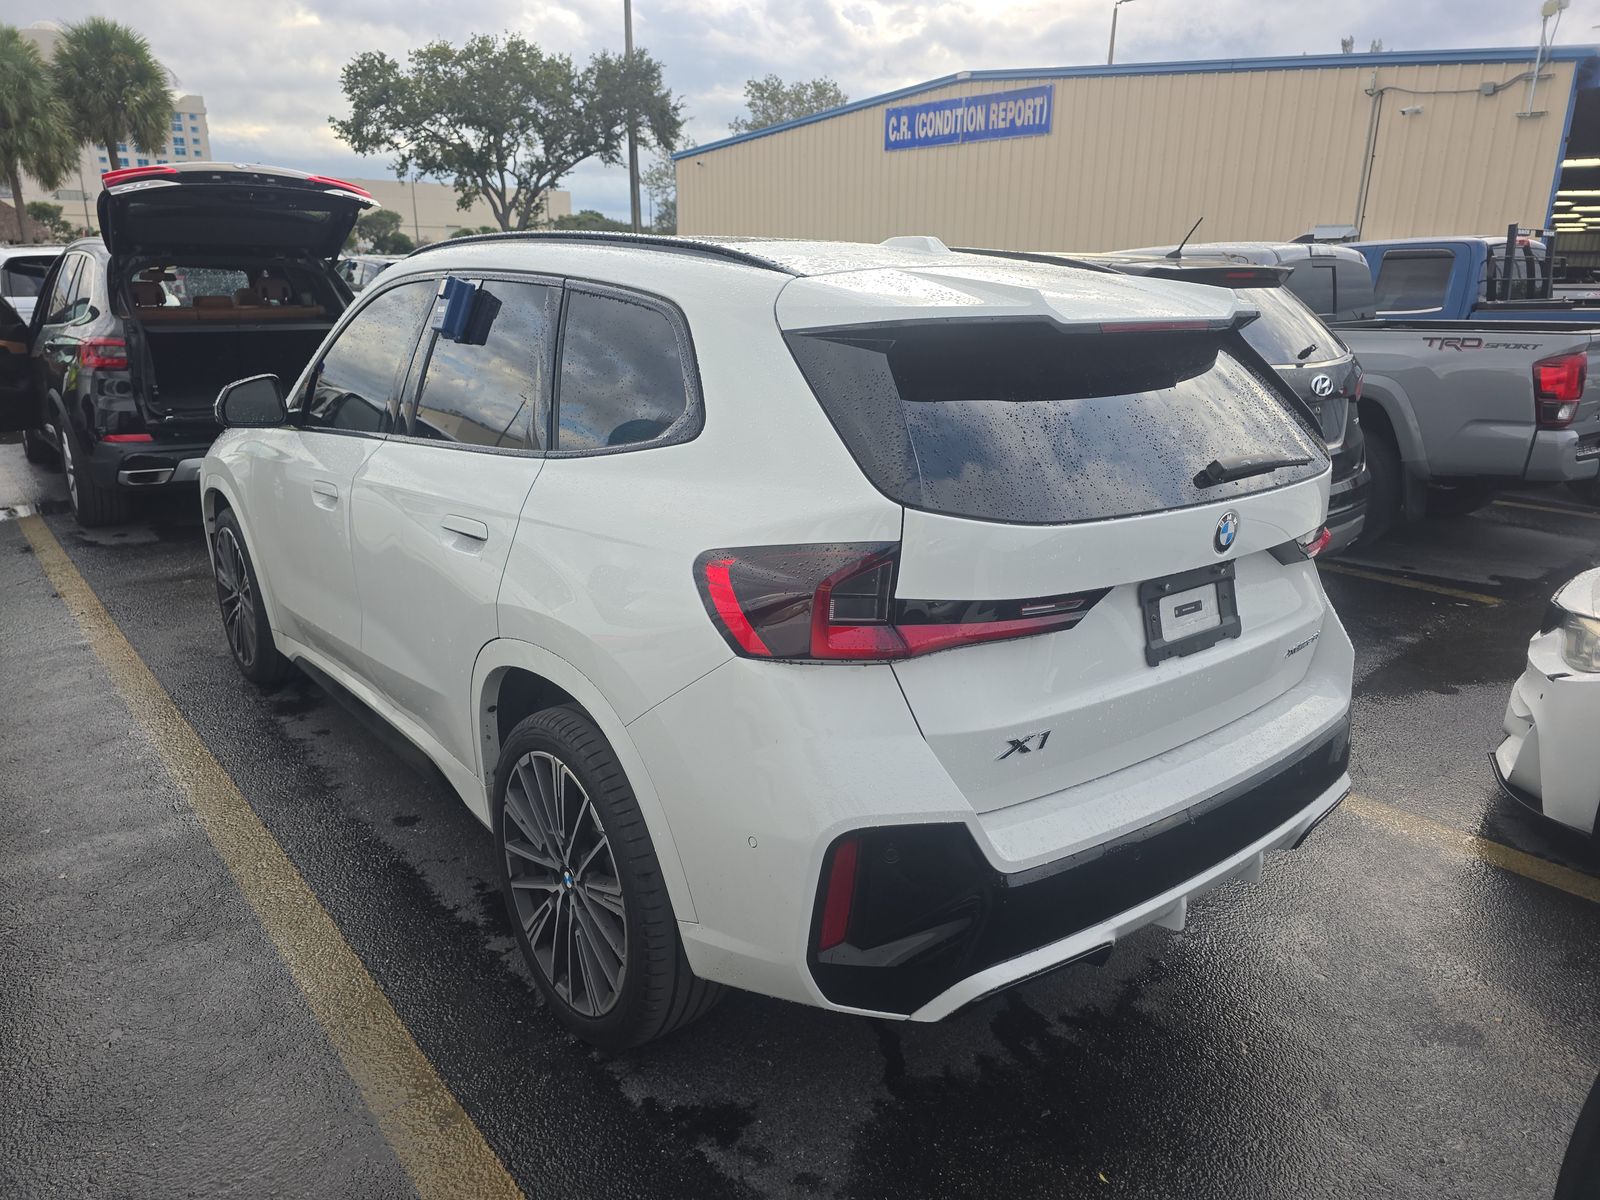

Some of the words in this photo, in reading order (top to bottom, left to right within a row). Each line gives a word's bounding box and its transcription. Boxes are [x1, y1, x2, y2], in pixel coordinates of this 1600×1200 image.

[888, 115, 911, 142] C.R.
[914, 103, 985, 140] (CONDITION
[988, 95, 1048, 130] REPORT)
[1422, 337, 1483, 352] TRD
[1484, 342, 1543, 351] SPORT
[995, 729, 1052, 761] X1
